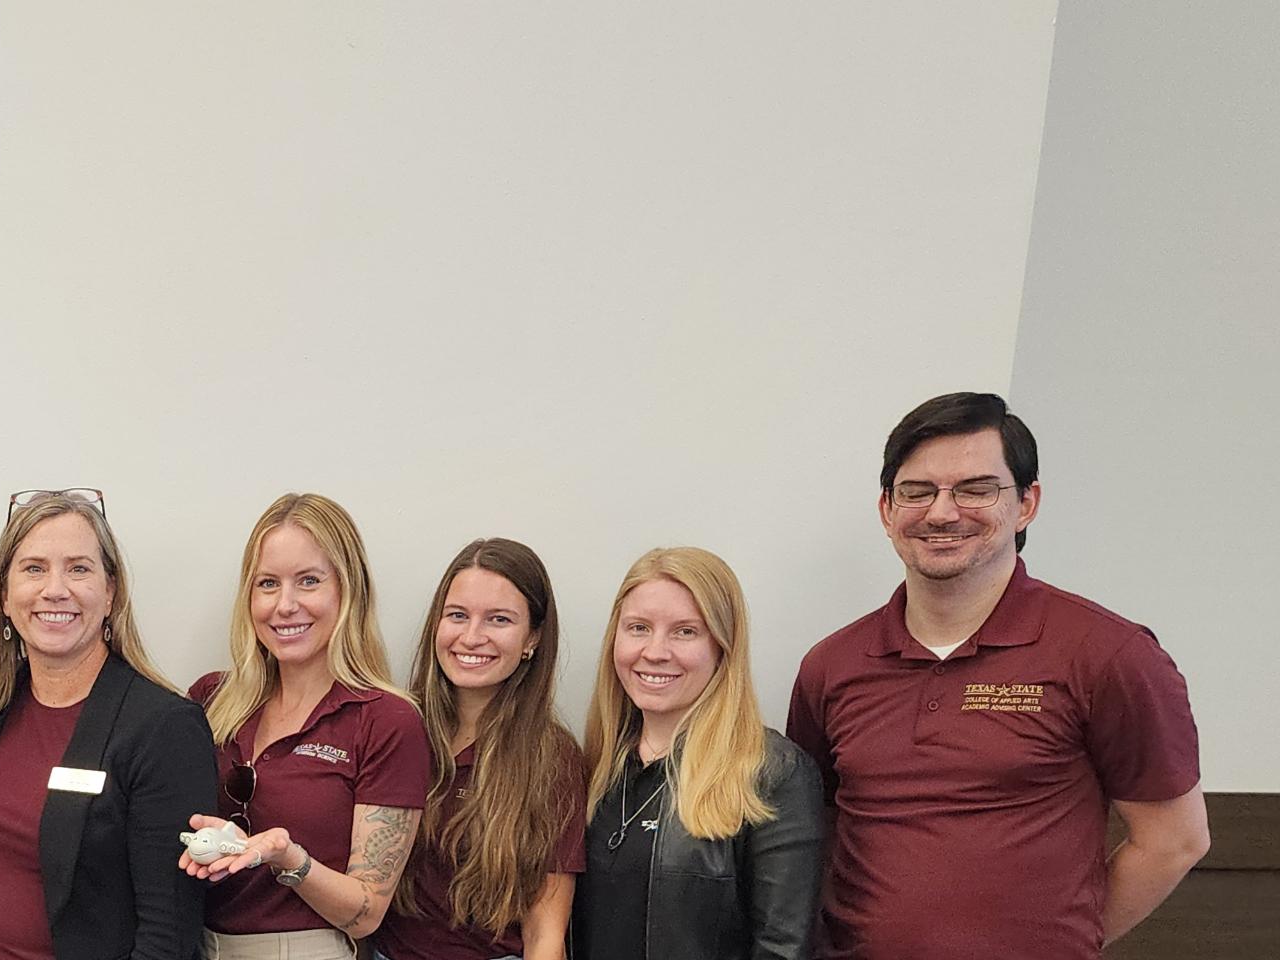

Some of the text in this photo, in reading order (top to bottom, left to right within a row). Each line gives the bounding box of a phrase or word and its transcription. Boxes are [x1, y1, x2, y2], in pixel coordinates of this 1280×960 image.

[965, 684, 1044, 694] TEXAS STATE
[322, 744, 348, 758] STATE
